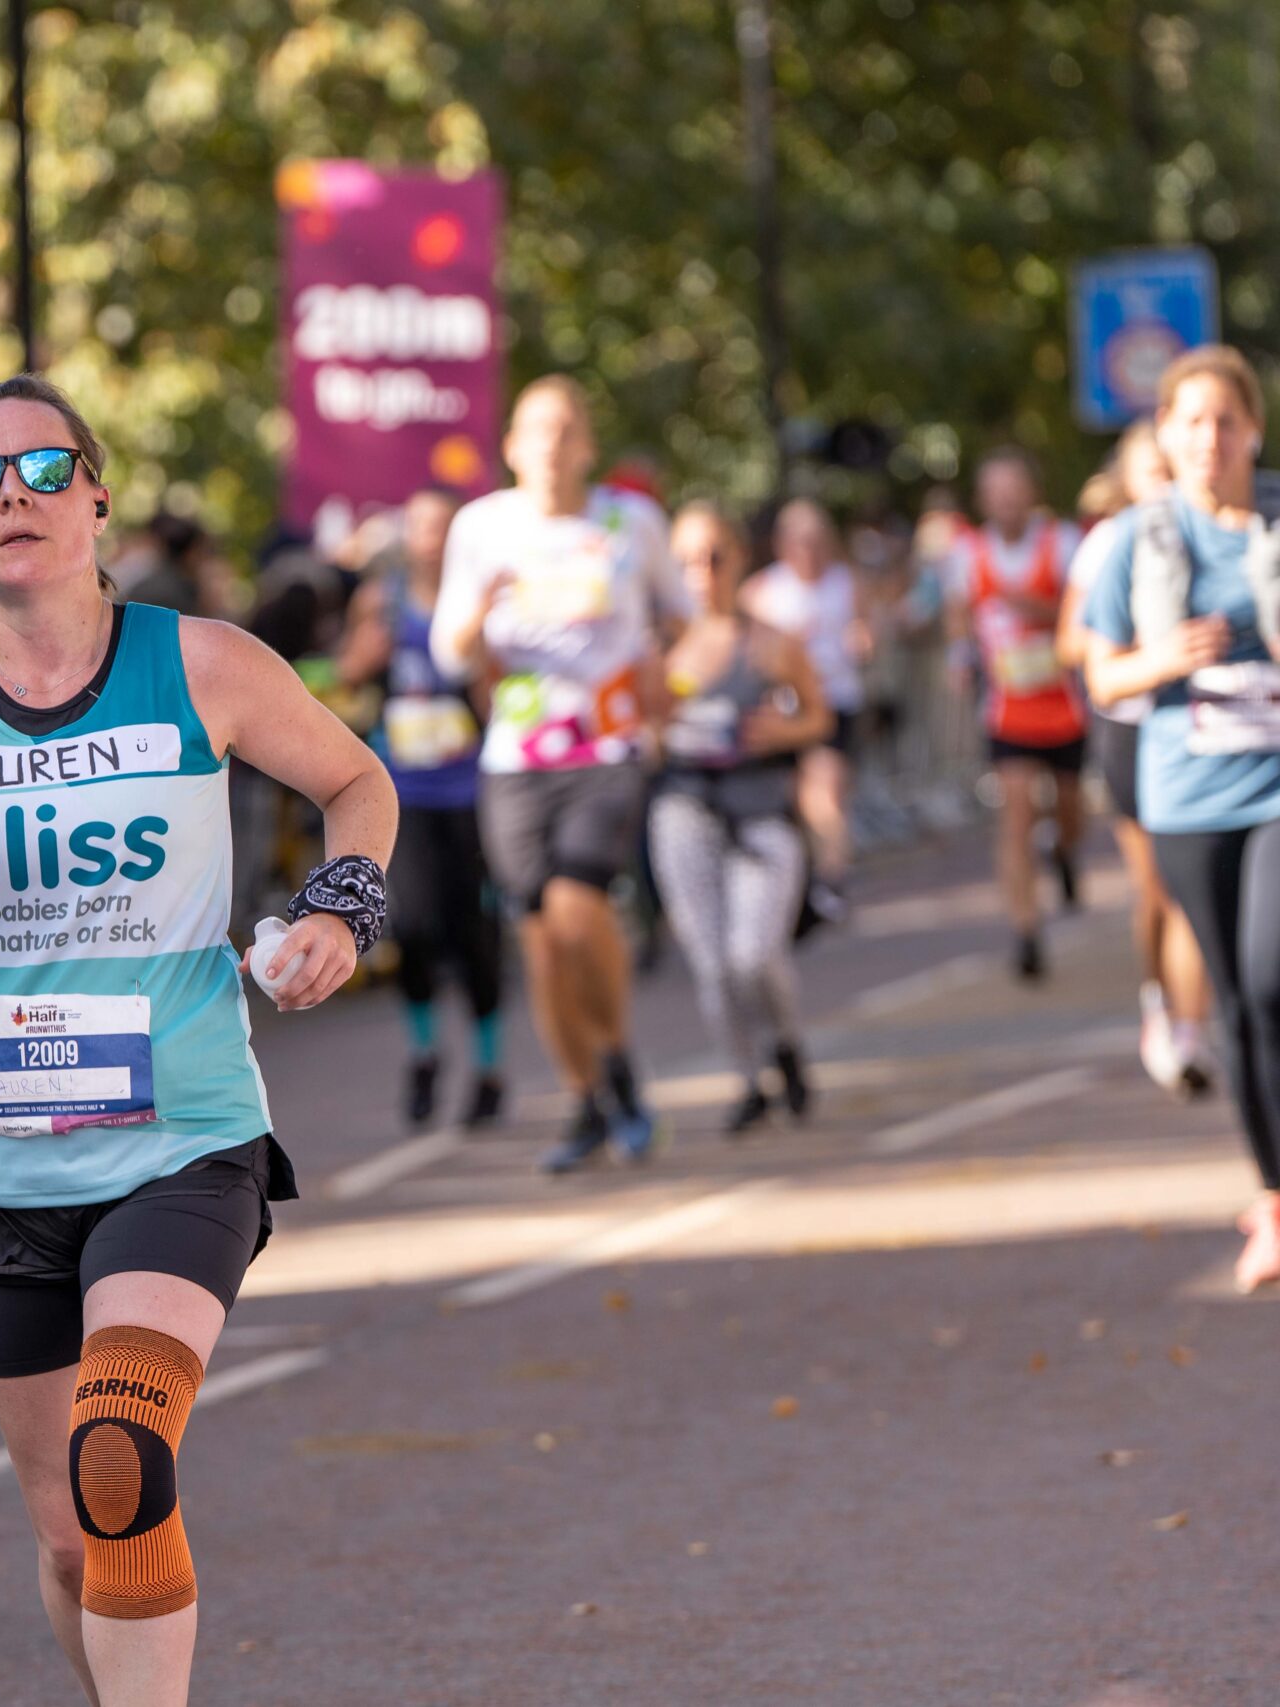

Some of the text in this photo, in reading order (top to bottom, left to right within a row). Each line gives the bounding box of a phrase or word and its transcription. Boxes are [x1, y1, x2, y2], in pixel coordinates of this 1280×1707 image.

[75, 894, 132, 918] born
[76, 926, 102, 943] or
[108, 917, 156, 942] sick
[29, 1010, 57, 1022] Half
[25, 1024, 66, 1034] #RUNWITHUS
[17, 1040, 79, 1068] 12009
[117, 1115, 140, 1124] T-SHIRT
[75, 1378, 169, 1409] BEARHUG
